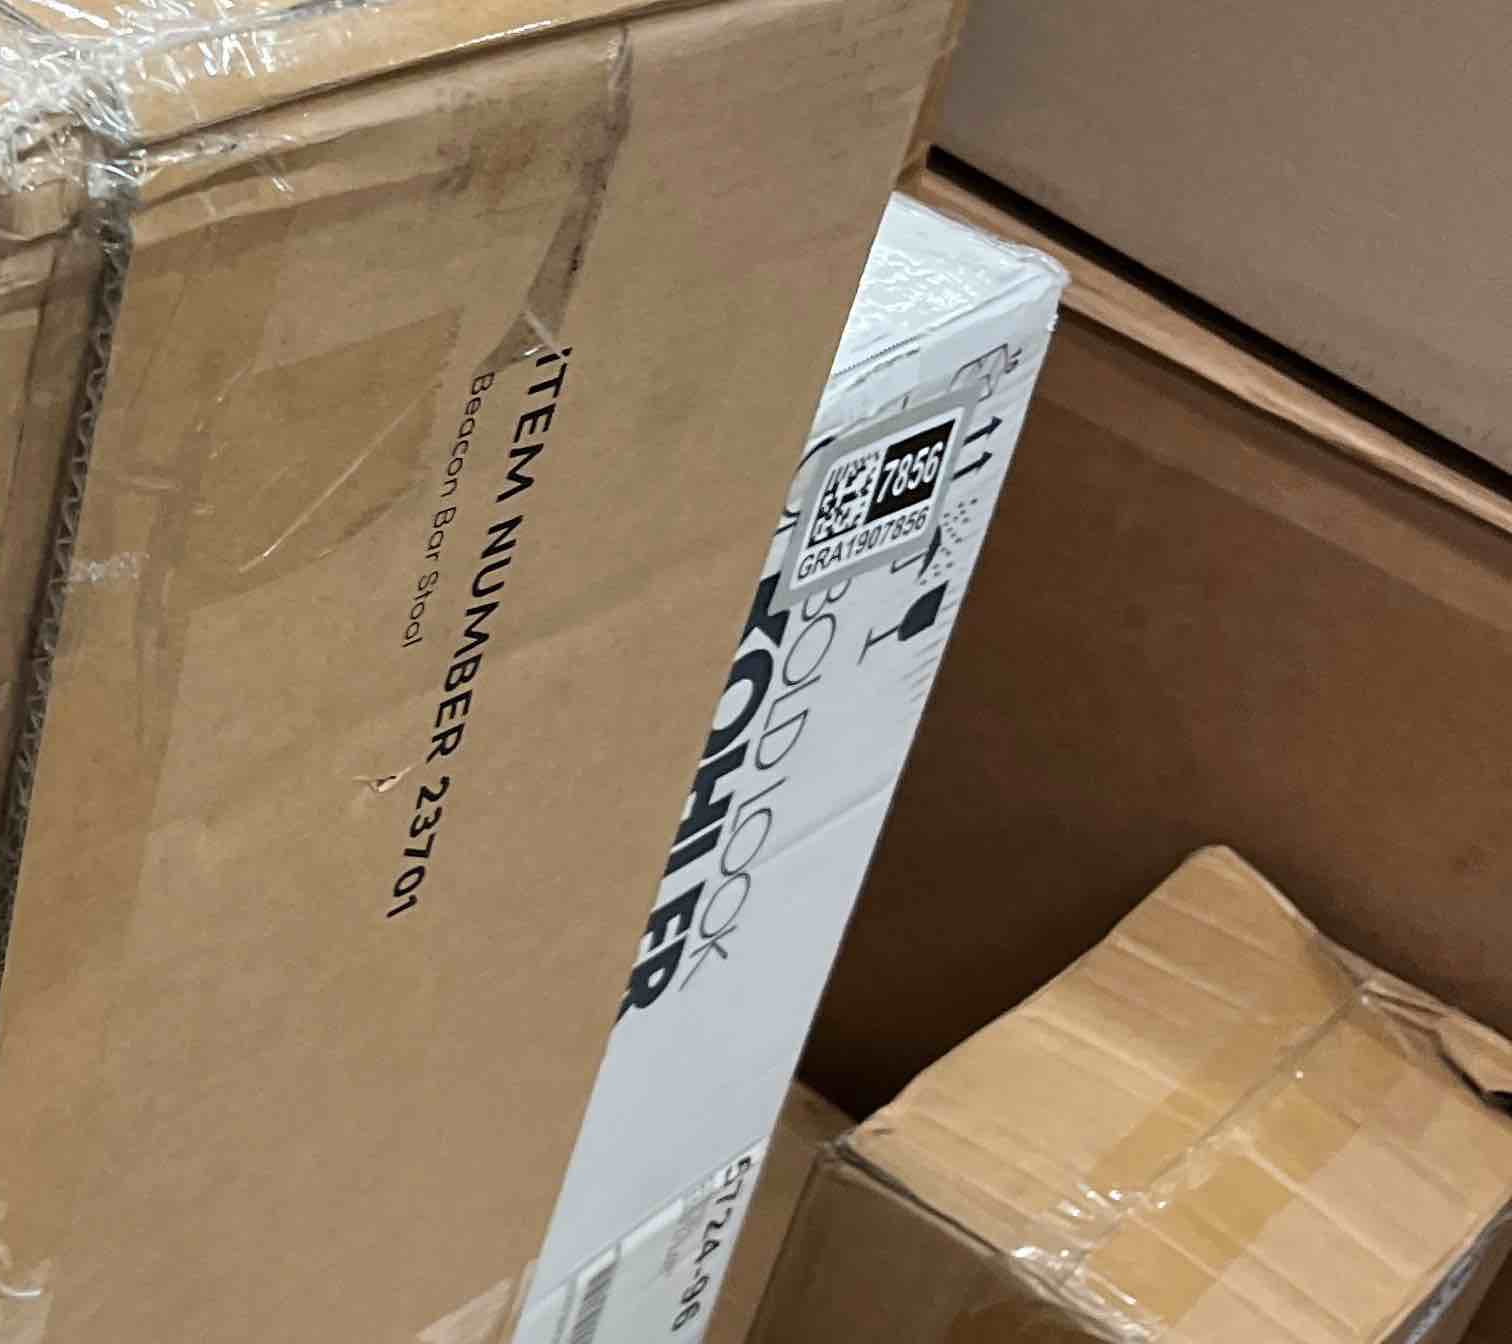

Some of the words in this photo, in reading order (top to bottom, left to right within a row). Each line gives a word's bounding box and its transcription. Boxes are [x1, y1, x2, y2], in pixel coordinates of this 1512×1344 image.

[439, 370, 496, 498] Beacon
[496, 346, 574, 504] ITEM
[875, 440, 944, 504] 7856
[425, 505, 457, 561] Bar
[797, 505, 930, 580] GRA1907856
[401, 570, 440, 648] Stool
[426, 514, 524, 765] NUMBER
[386, 775, 451, 919] 23701
[679, 775, 788, 992] LOOK
